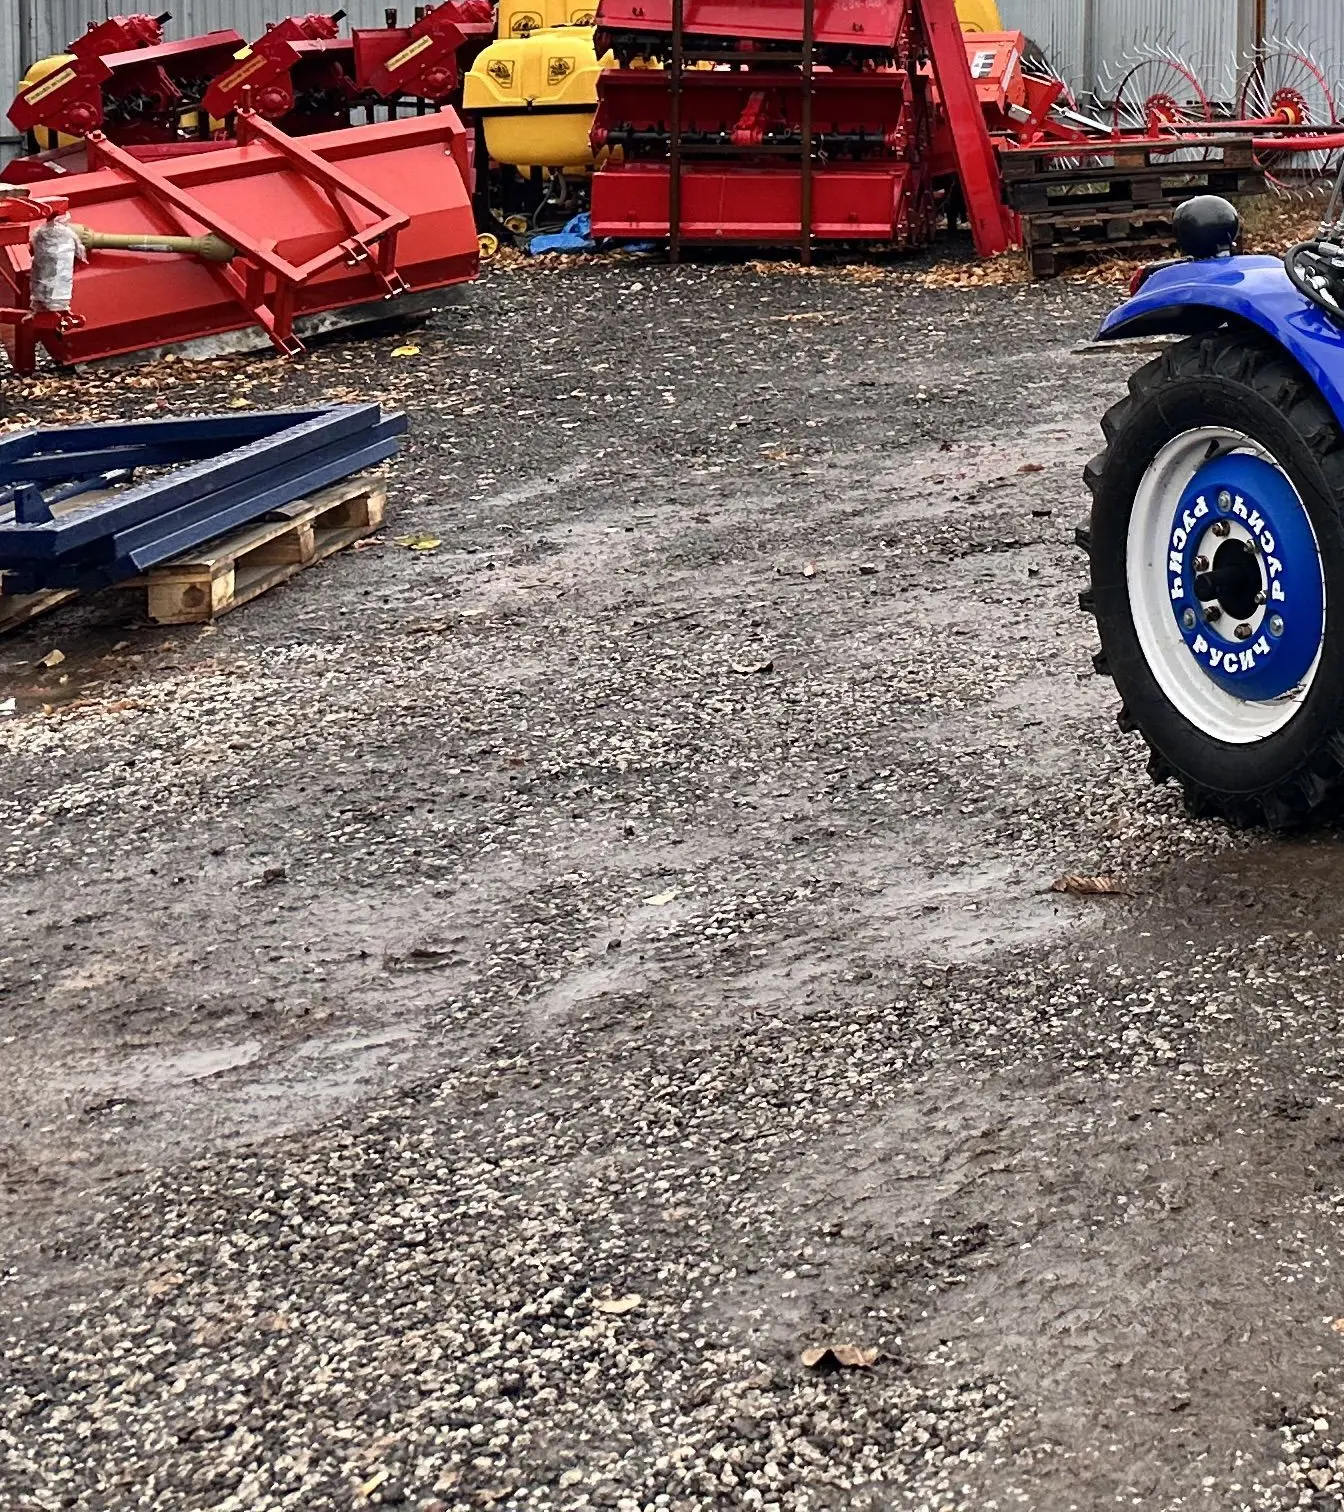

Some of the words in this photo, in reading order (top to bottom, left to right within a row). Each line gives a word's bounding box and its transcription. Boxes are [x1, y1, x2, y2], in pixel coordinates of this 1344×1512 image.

[1169, 495, 1209, 600] РУСИЧ
[1232, 494, 1286, 602] РУСИЧ
[1191, 634, 1271, 674] РУСИЧ
